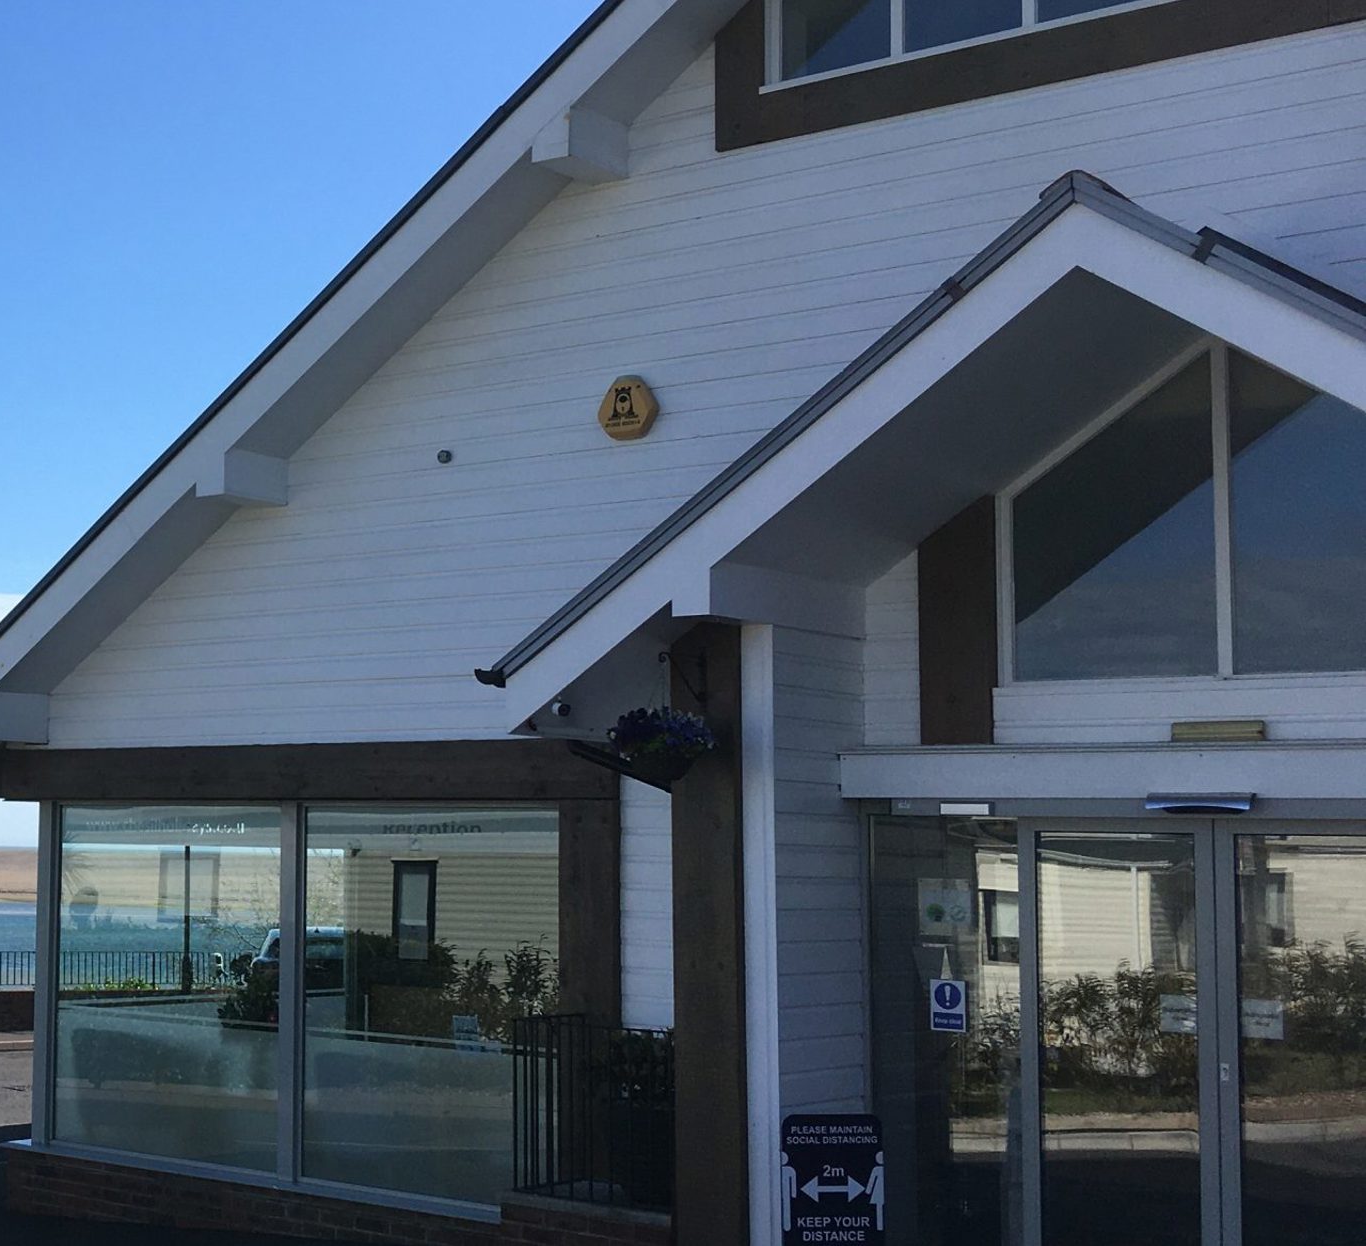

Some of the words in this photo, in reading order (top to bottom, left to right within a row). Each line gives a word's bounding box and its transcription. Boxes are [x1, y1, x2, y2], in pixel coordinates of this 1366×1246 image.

[791, 1126, 827, 1134] PLEASE
[829, 1126, 873, 1134] MAINTAIN
[786, 1136, 821, 1144] SOCIAL
[823, 1136, 878, 1144] DISTANCING
[823, 1165, 844, 1177] 2m
[797, 1217, 831, 1227] KEEP
[834, 1217, 870, 1227] YOUR
[803, 1231, 865, 1241] DISTANCE
